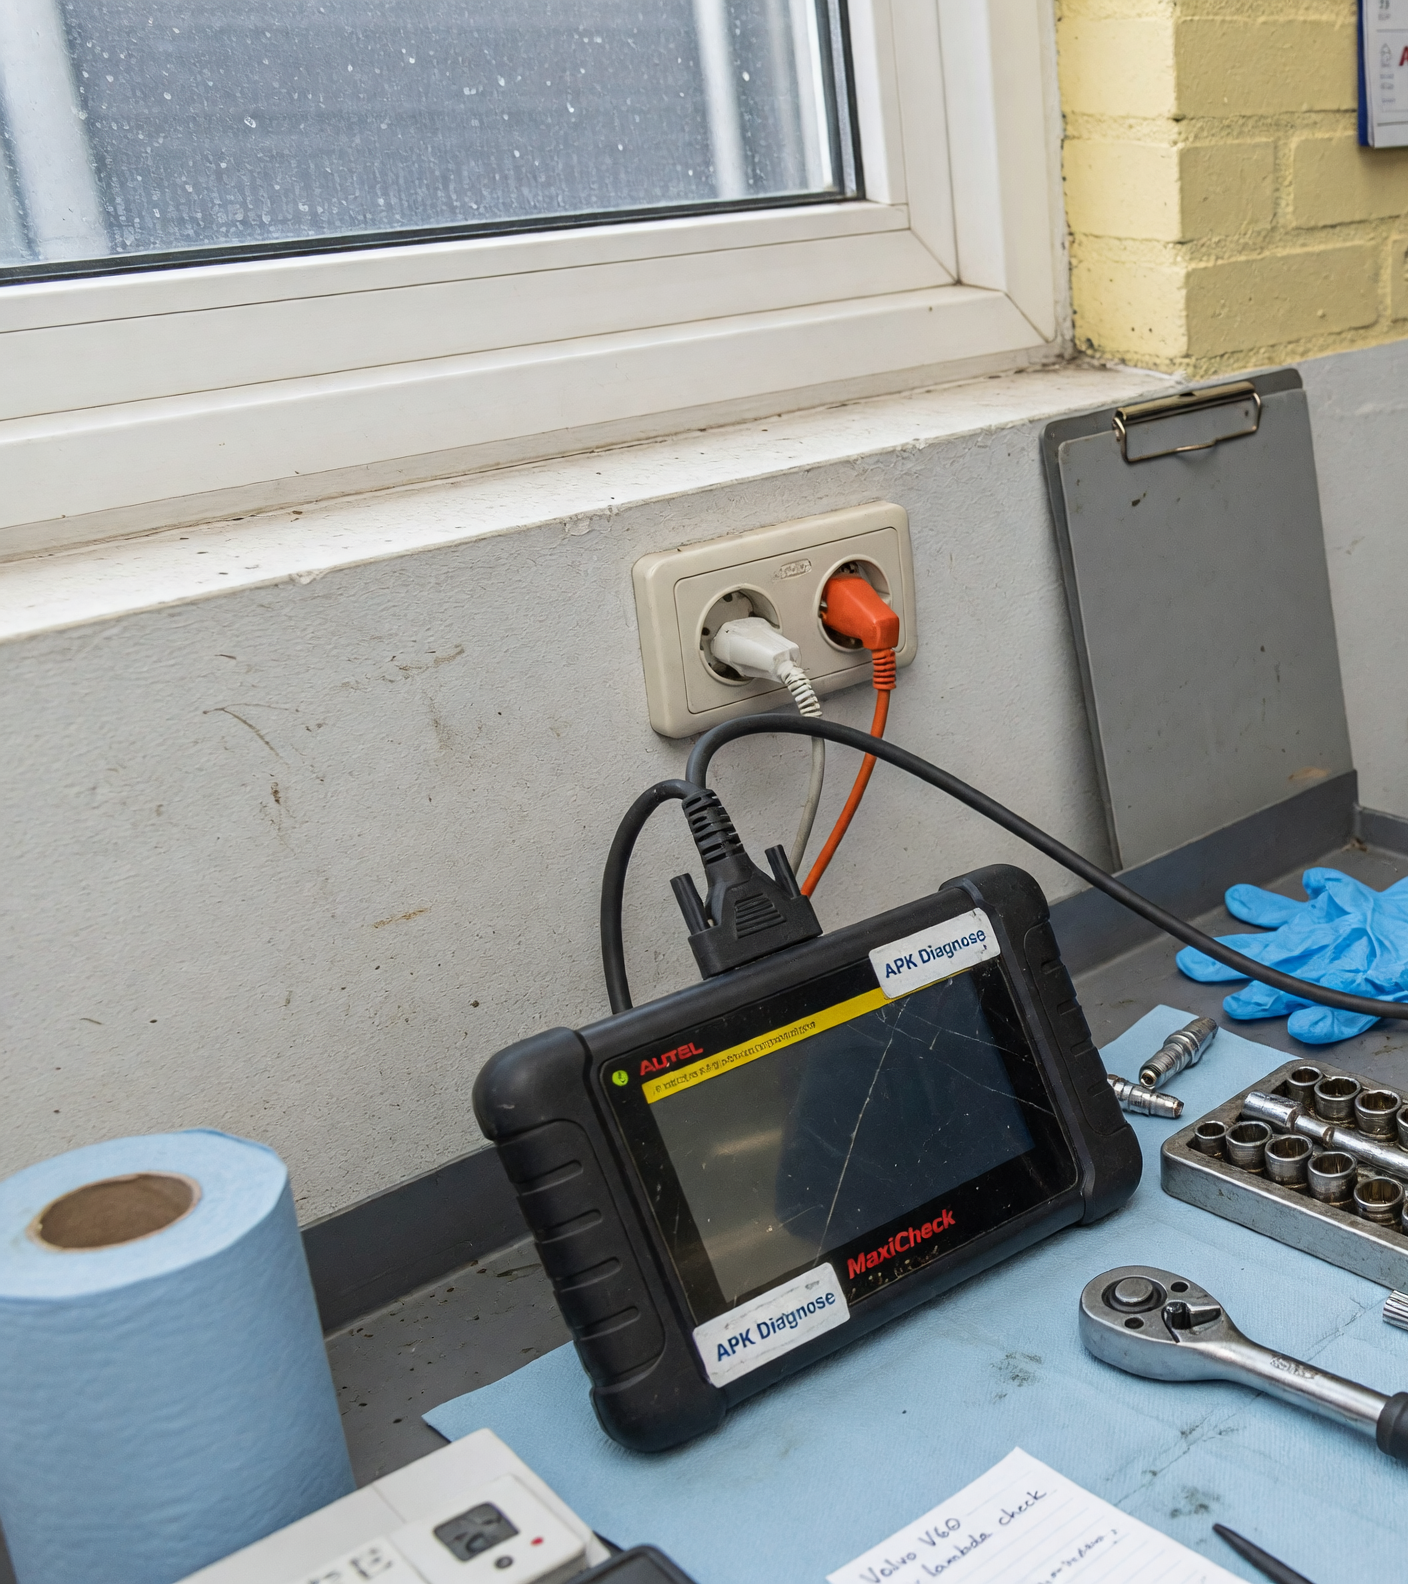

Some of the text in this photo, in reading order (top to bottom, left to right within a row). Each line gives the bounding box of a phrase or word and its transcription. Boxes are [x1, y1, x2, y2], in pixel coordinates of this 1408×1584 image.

[885, 929, 987, 979] APK Diagnose
[640, 1042, 703, 1076] AUTEL
[846, 1208, 956, 1280] MaxiCheck
[717, 1292, 836, 1361] APK Diagnose
[921, 1531, 993, 1577] lambda
[998, 1490, 1047, 1526] check
